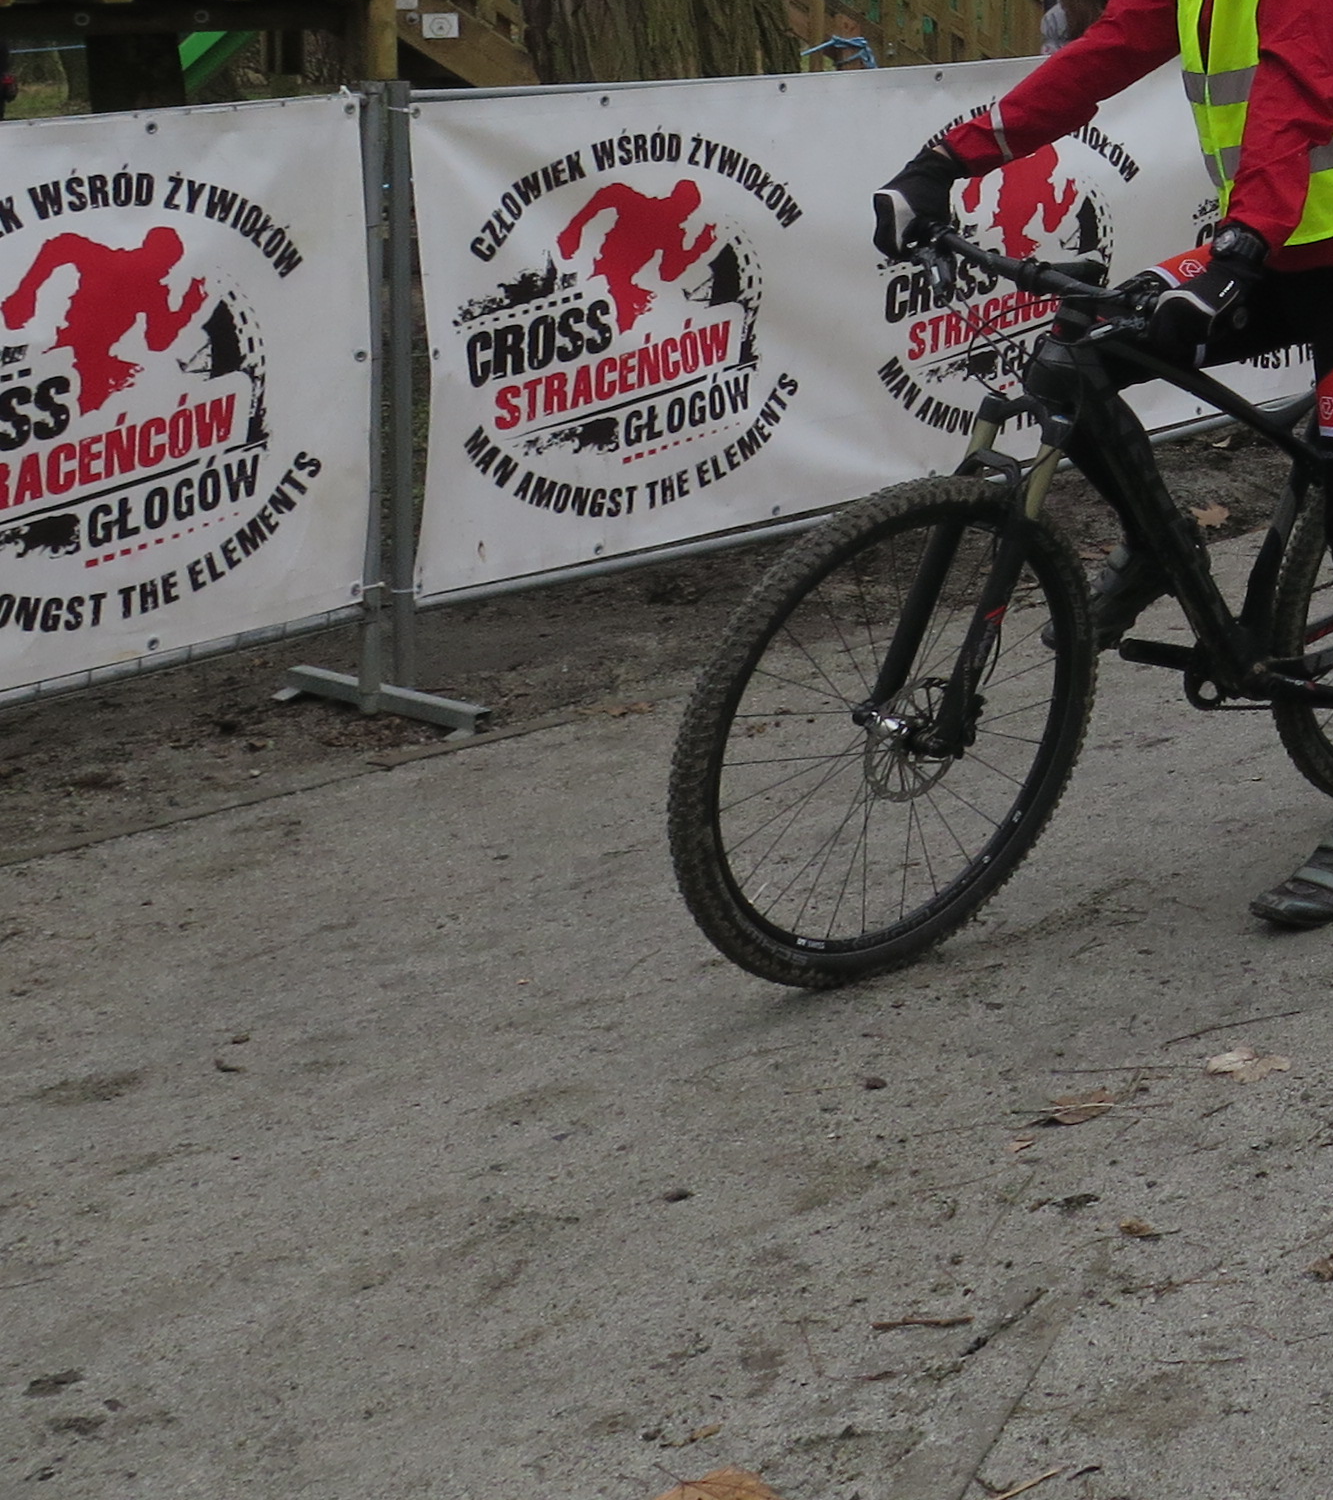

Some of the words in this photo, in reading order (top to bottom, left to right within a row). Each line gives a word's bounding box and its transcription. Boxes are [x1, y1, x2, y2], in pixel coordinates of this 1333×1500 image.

[27, 163, 155, 220] WŚRÓD
[163, 171, 303, 279] ŻYWIOŁÓW
[469, 150, 587, 263] CZŁOWIEK
[591, 125, 682, 172] WŚRÓD
[687, 132, 804, 229] ŻYWIOŁÓW
[466, 298, 613, 388] CROSS
[494, 317, 731, 430] STRACEŃCÓW
[877, 356, 922, 412] MAN
[915, 396, 980, 437] AMON
[463, 425, 519, 489] MAN
[512, 470, 638, 518] AMONGST
[645, 468, 692, 510] THE
[698, 372, 800, 488] ELEMENTS
[623, 372, 751, 448] GŁOGÓW
[0, 592, 108, 633] ONGST
[118, 570, 181, 620] THE
[187, 451, 323, 593] ELEMENTS
[87, 454, 260, 549] GŁOGÓW
